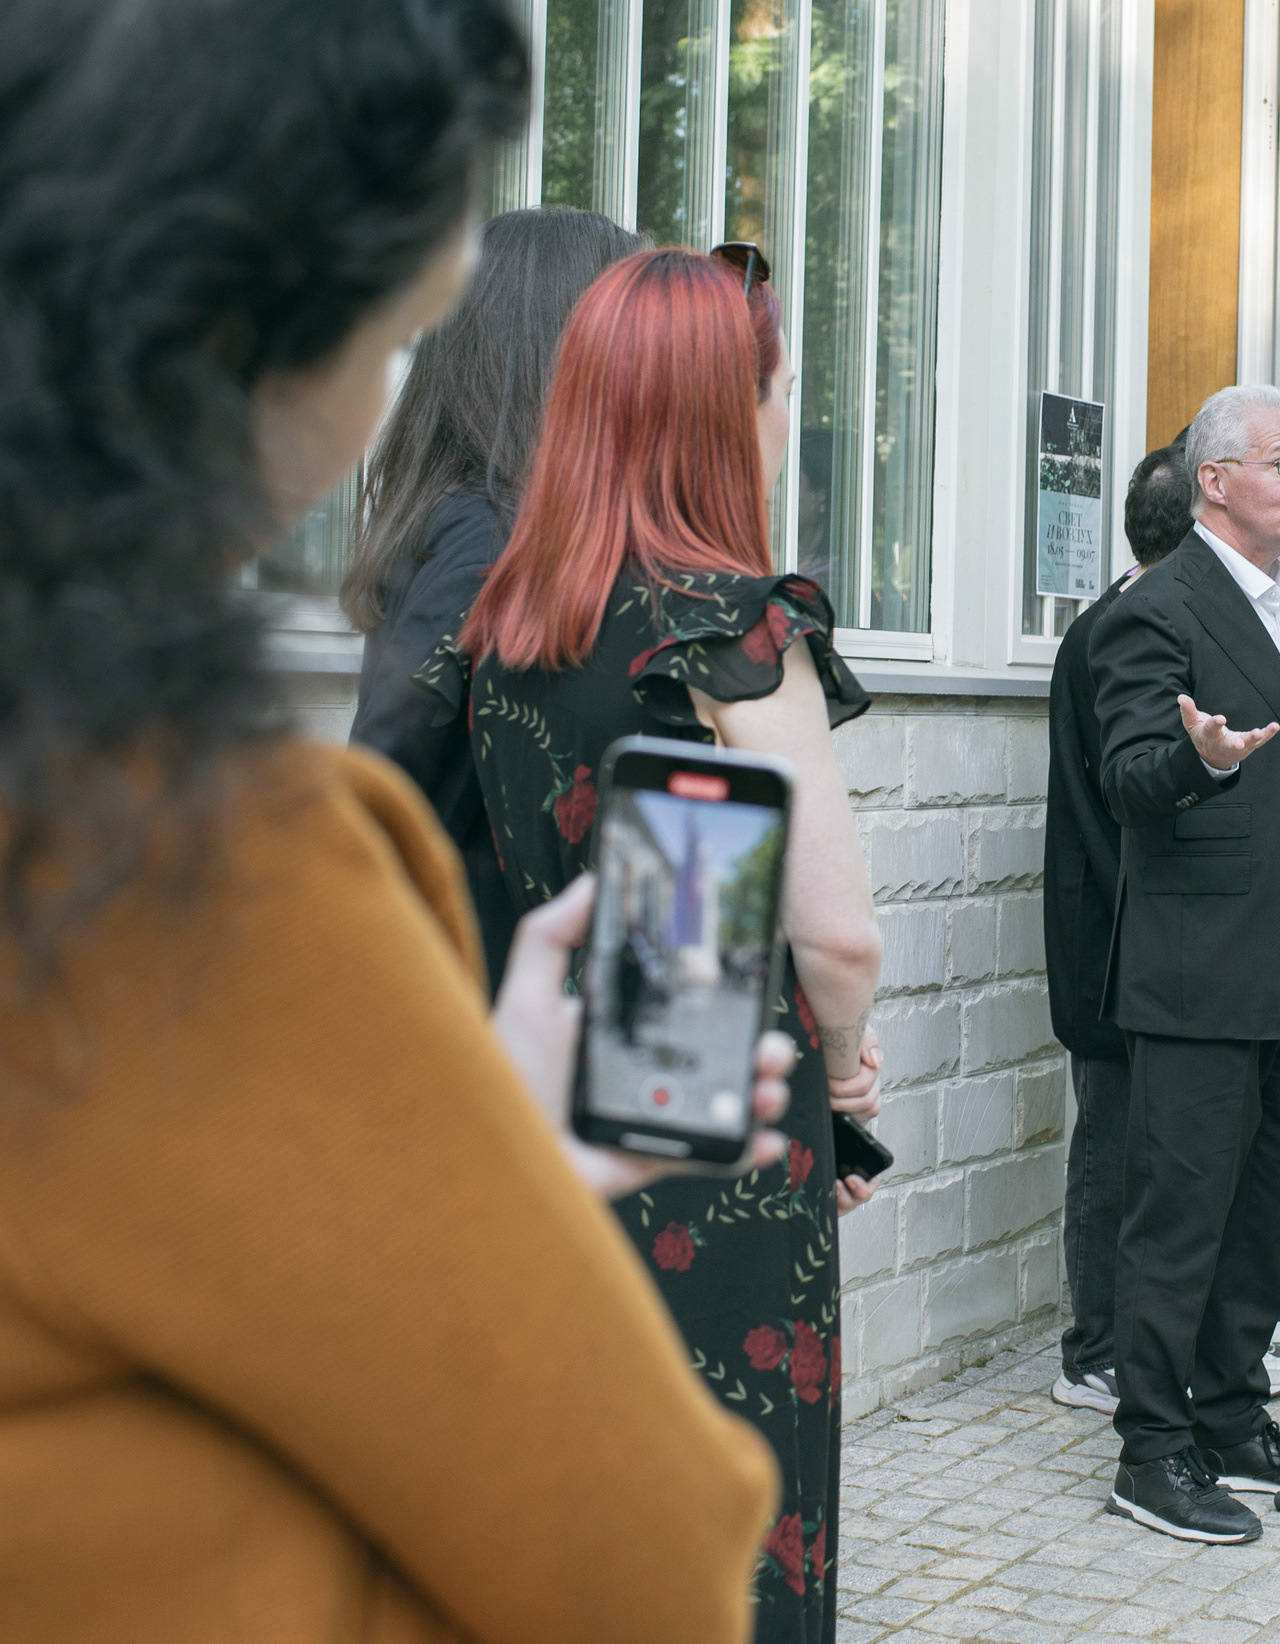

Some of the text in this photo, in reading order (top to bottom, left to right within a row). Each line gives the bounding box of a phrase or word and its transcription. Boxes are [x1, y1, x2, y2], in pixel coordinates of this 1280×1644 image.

[1058, 510, 1083, 527] СВЕТ
[1046, 524, 1093, 545] И ВОЗДУХ
